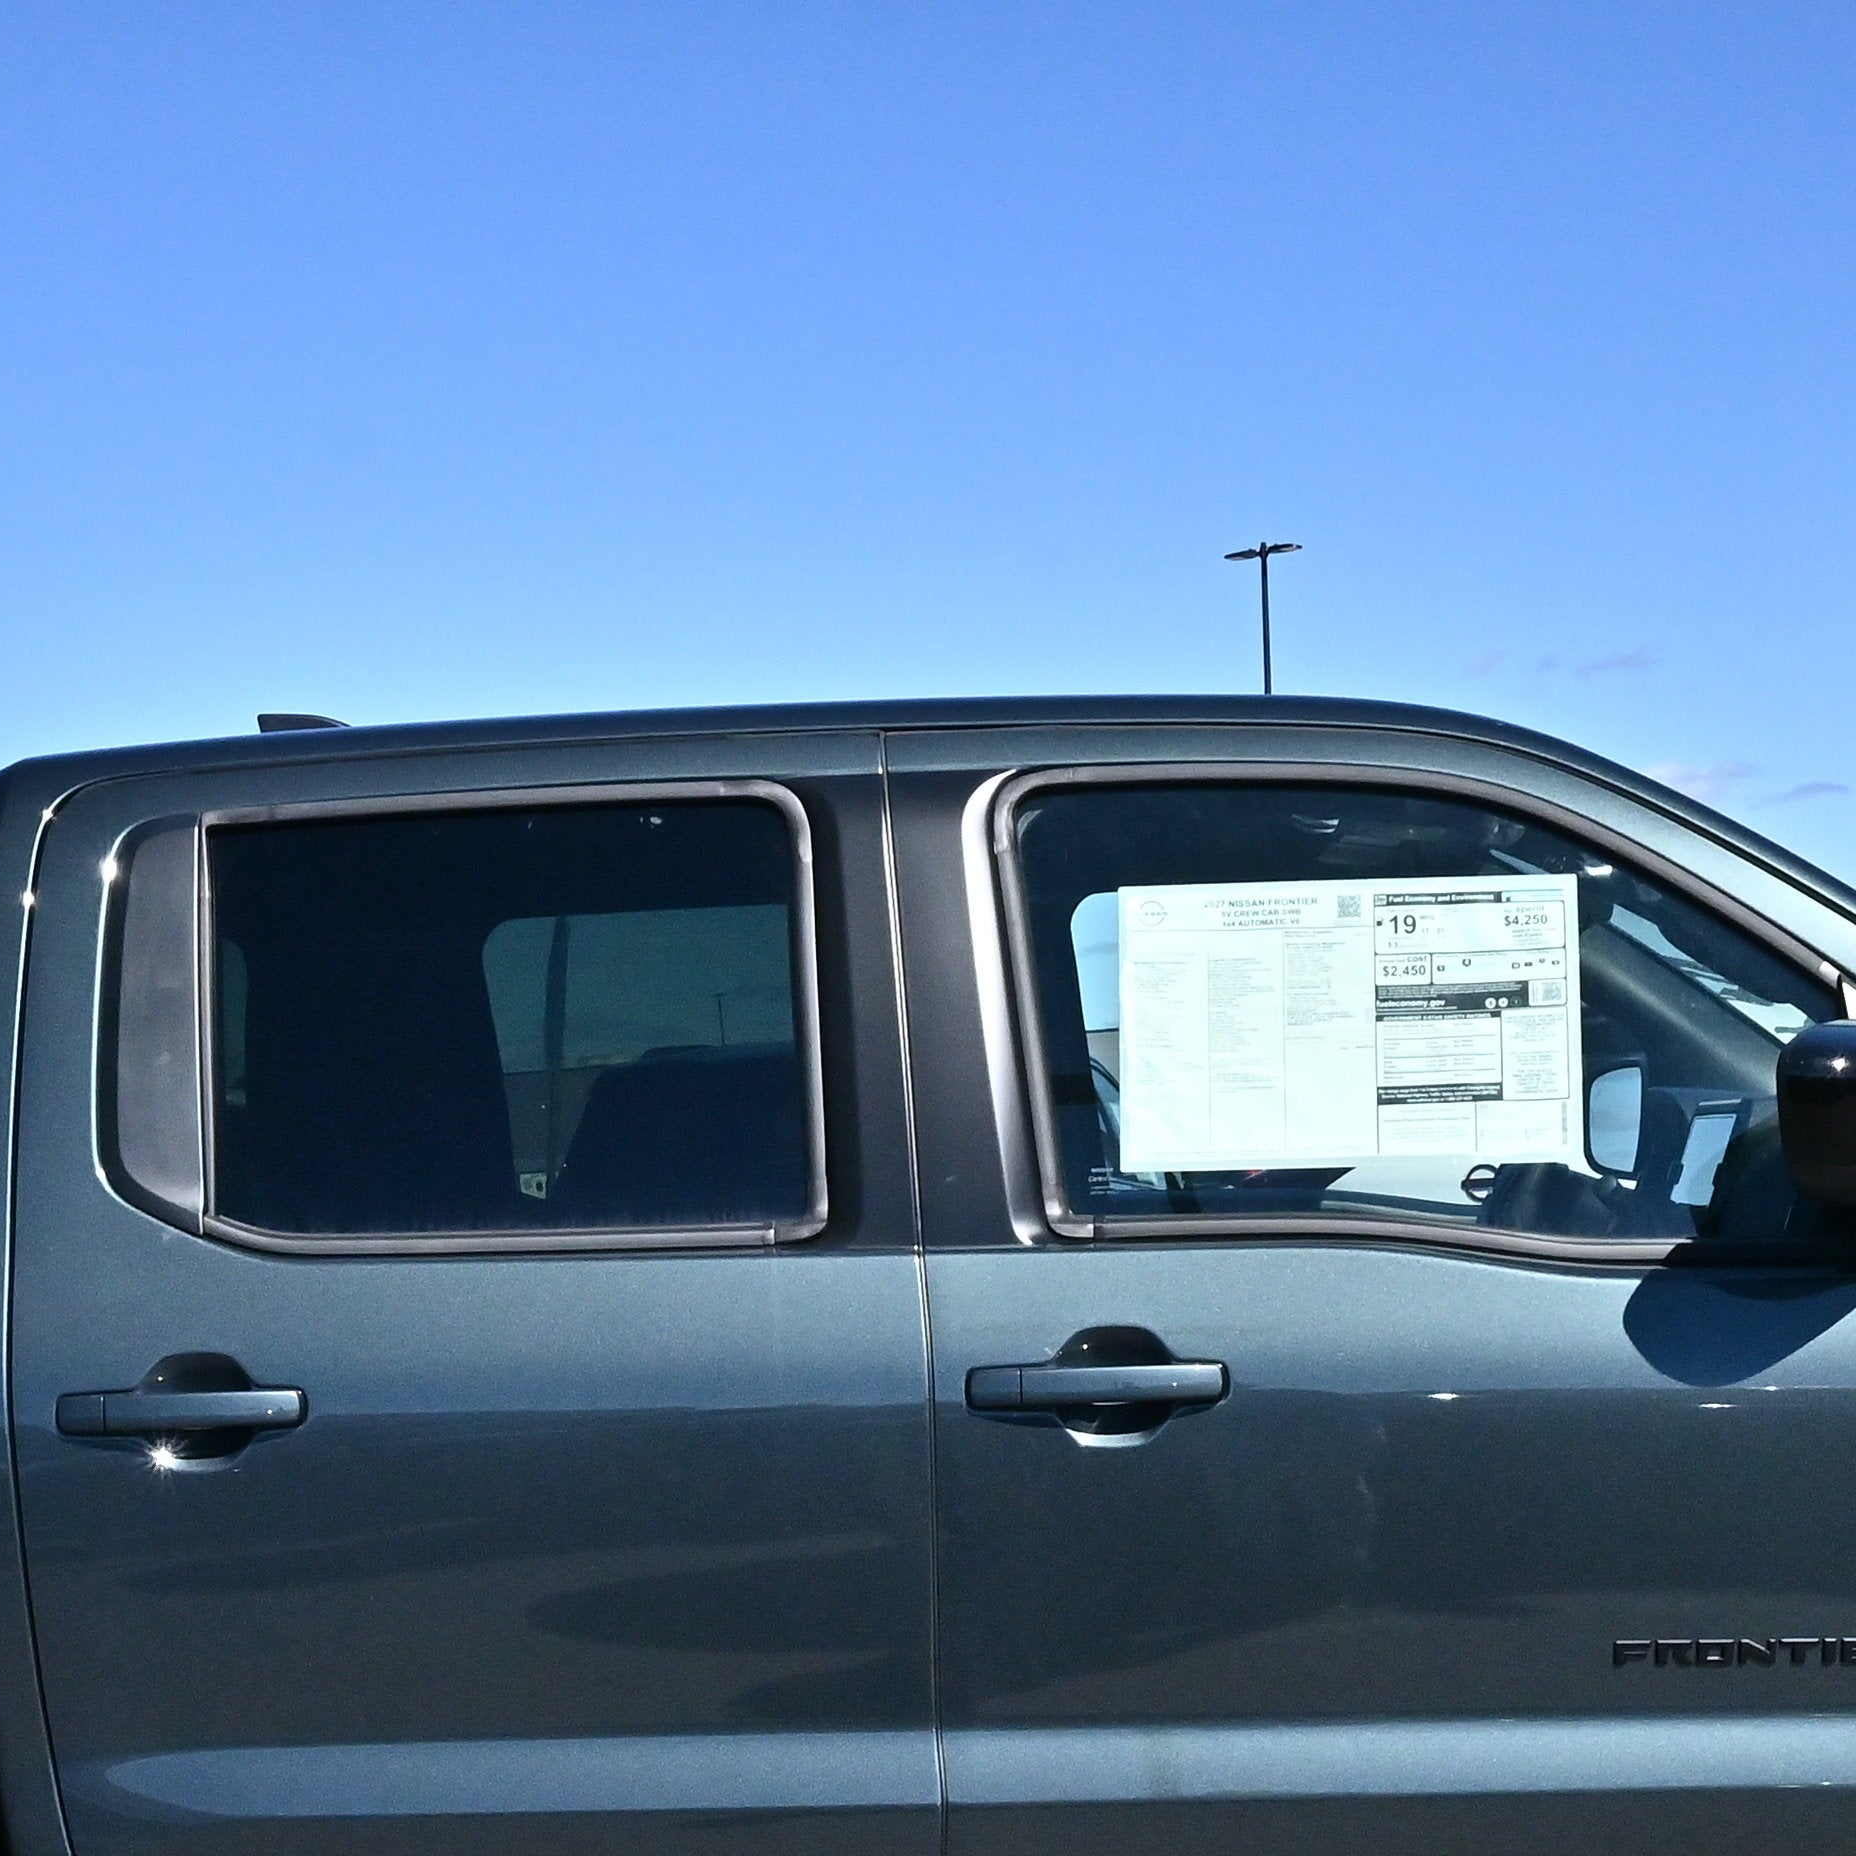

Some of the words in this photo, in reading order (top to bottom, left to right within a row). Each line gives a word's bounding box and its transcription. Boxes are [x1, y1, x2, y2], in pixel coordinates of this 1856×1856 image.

[1228, 899, 1265, 908] NISSAN
[1268, 897, 1318, 906] FRONTIER
[1389, 914, 1416, 934] 19
[1504, 914, 1548, 927] $4,250
[1383, 965, 1426, 978] $2,450
